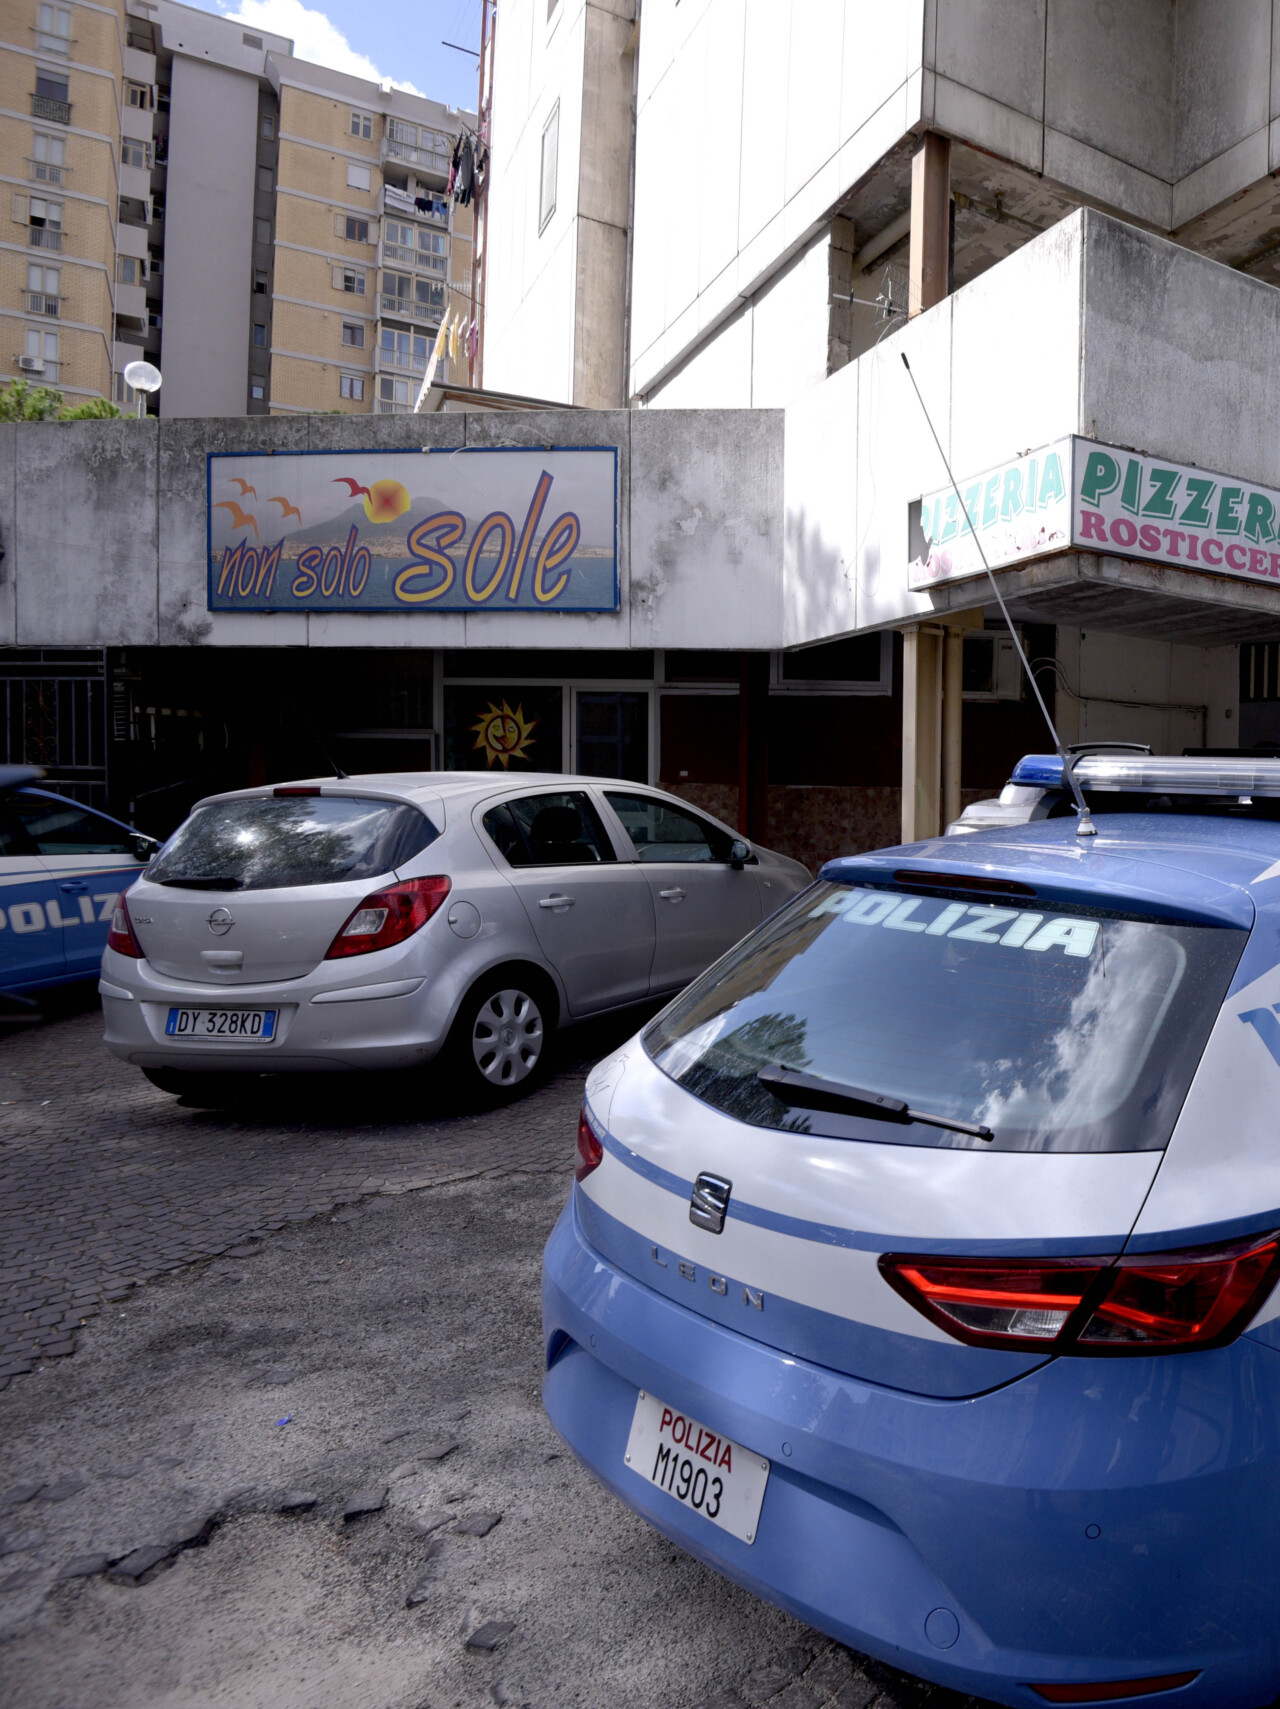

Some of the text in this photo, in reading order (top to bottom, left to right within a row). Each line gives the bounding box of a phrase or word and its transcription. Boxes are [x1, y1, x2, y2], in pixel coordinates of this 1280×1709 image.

[216, 536, 285, 599] non
[292, 524, 371, 599] solo
[808, 890, 1100, 958] POLIZIA
[178, 1011, 201, 1033] DY
[206, 1012, 262, 1035] 328KD
[652, 1246, 764, 1312] LEON
[660, 1407, 731, 1474] POLIZIA
[652, 1442, 723, 1519] M1903
